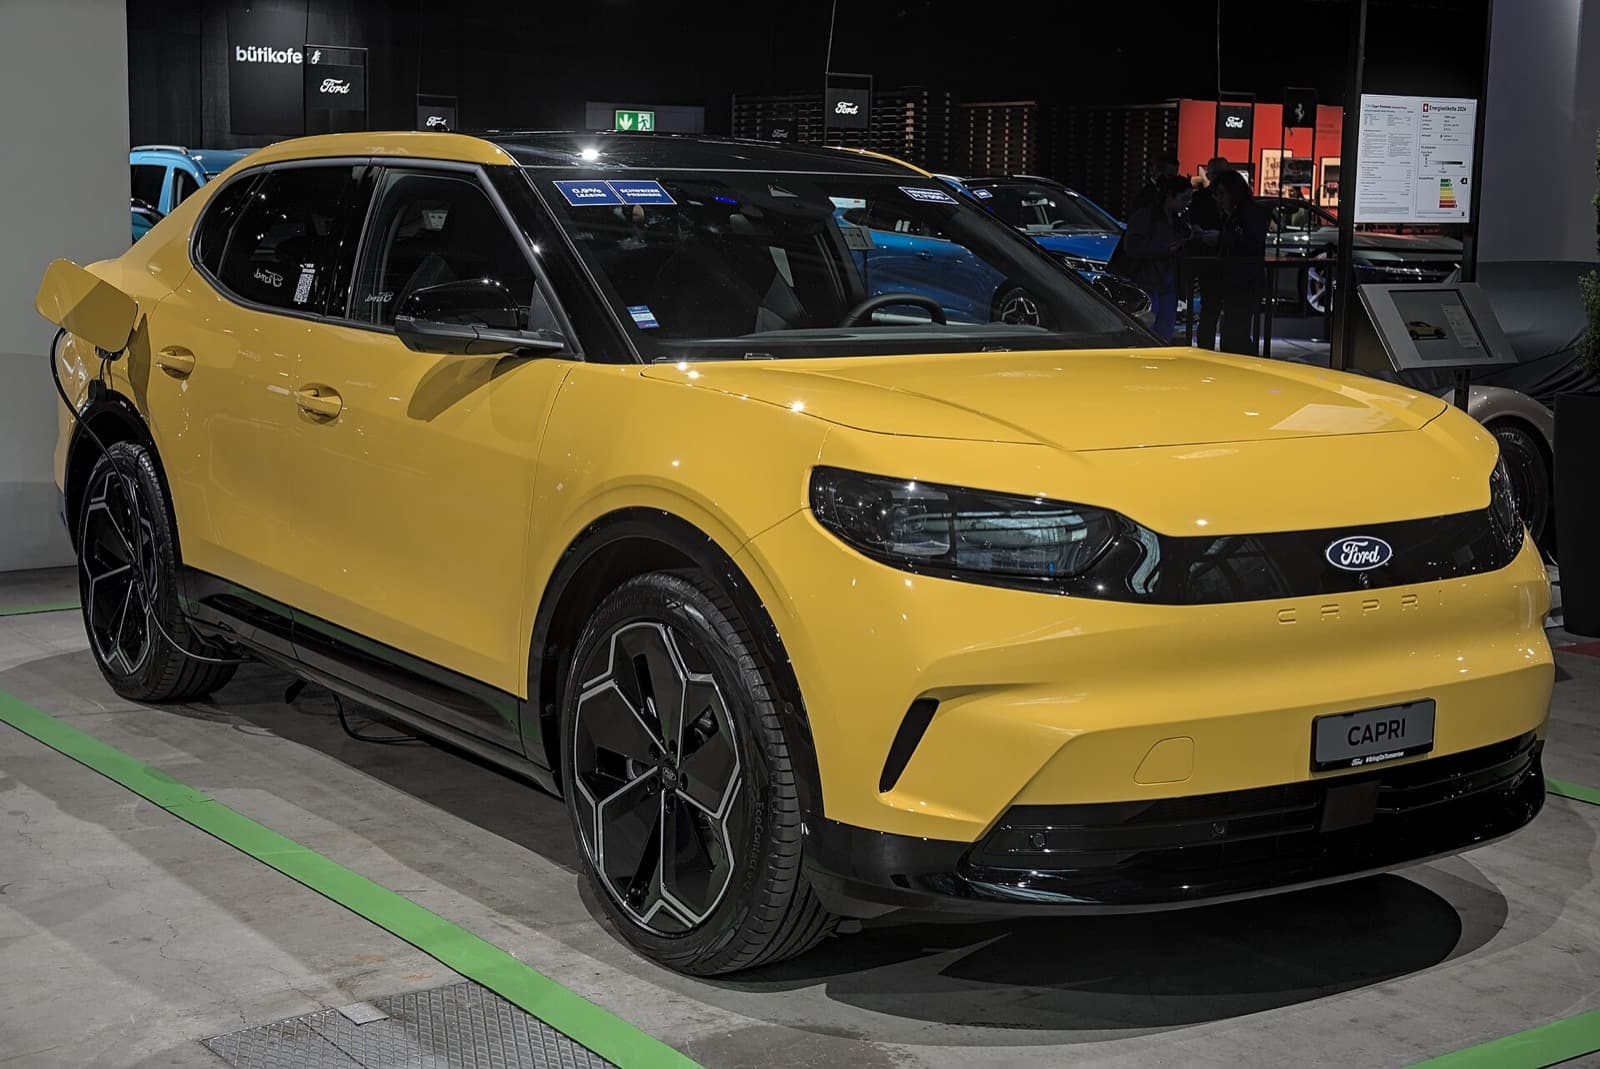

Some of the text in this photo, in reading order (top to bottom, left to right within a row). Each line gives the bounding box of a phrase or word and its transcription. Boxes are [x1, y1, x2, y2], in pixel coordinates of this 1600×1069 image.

[236, 46, 308, 64] bütikofe
[320, 78, 350, 94] Ford
[835, 101, 858, 115] Ford
[1225, 116, 1244, 128] Ford
[1340, 540, 1380, 566] Ford
[1277, 589, 1443, 625] CAPR
[1347, 717, 1406, 746] CAPRI
